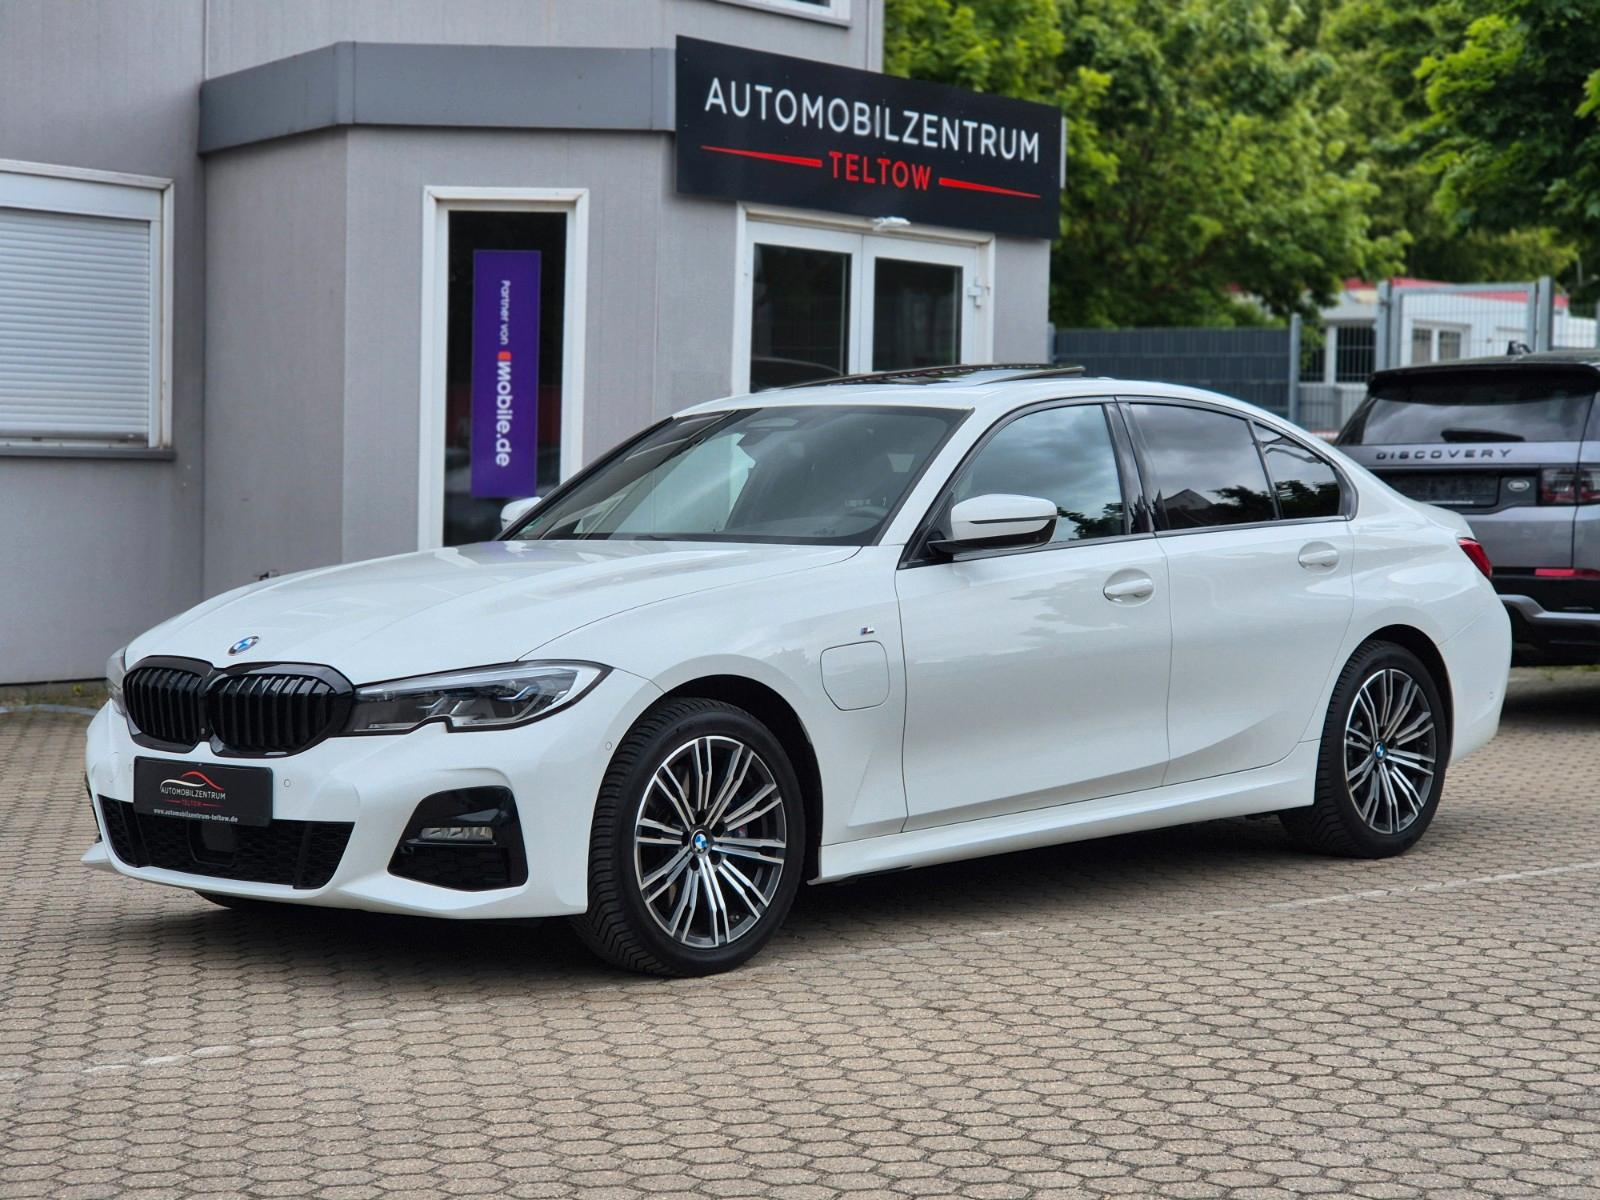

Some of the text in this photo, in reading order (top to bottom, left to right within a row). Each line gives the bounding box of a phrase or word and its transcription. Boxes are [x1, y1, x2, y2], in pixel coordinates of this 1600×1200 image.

[704, 77, 1039, 164] AUTOMOBILZENTRUM
[828, 151, 932, 191] TELTOW
[496, 280, 513, 467] Partner von mobile.de
[1375, 448, 1512, 460] DISCOVERY
[160, 787, 226, 799] AUTOMOBILZENTRUM
